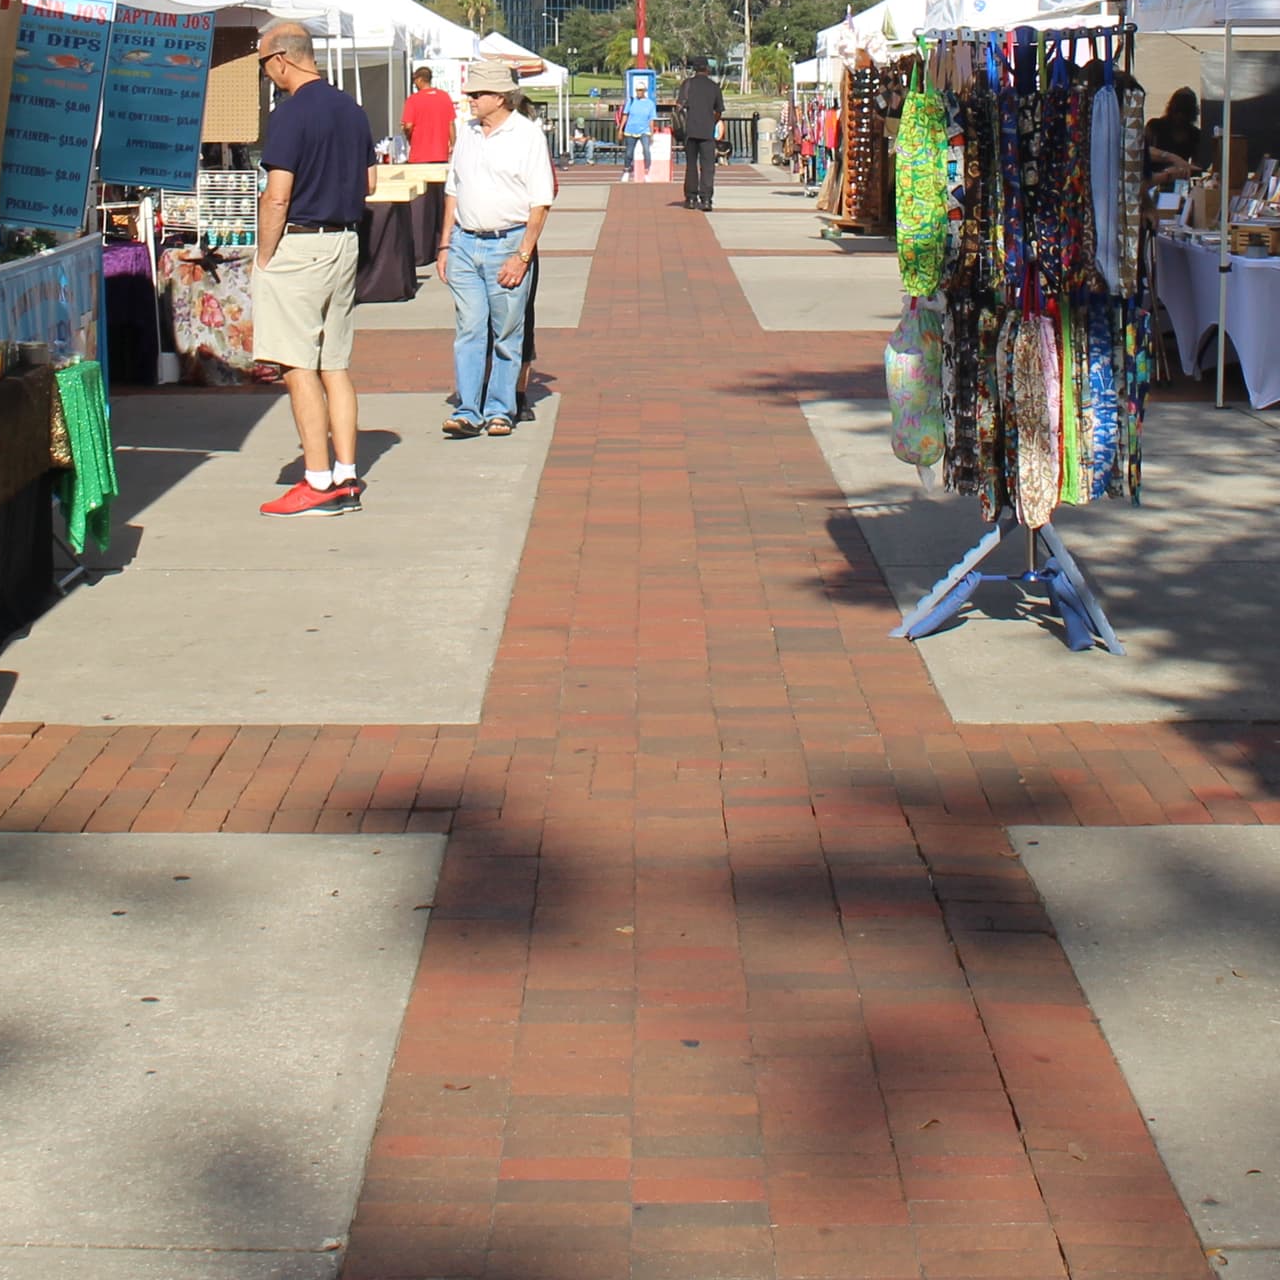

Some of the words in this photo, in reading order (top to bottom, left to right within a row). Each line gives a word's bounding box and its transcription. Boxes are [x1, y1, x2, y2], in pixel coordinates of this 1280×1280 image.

[71, 3, 108, 25] JO'S
[117, 8, 177, 27] CAPTAIN
[183, 14, 211, 31] JO'S
[47, 32, 101, 52] DIPS
[113, 33, 156, 47] FISH
[164, 38, 207, 52] DIPS
[9, 93, 61, 108] ONTAINER-
[5, 128, 56, 143] ONTAINER-
[52, 203, 79, 217] $4.00
